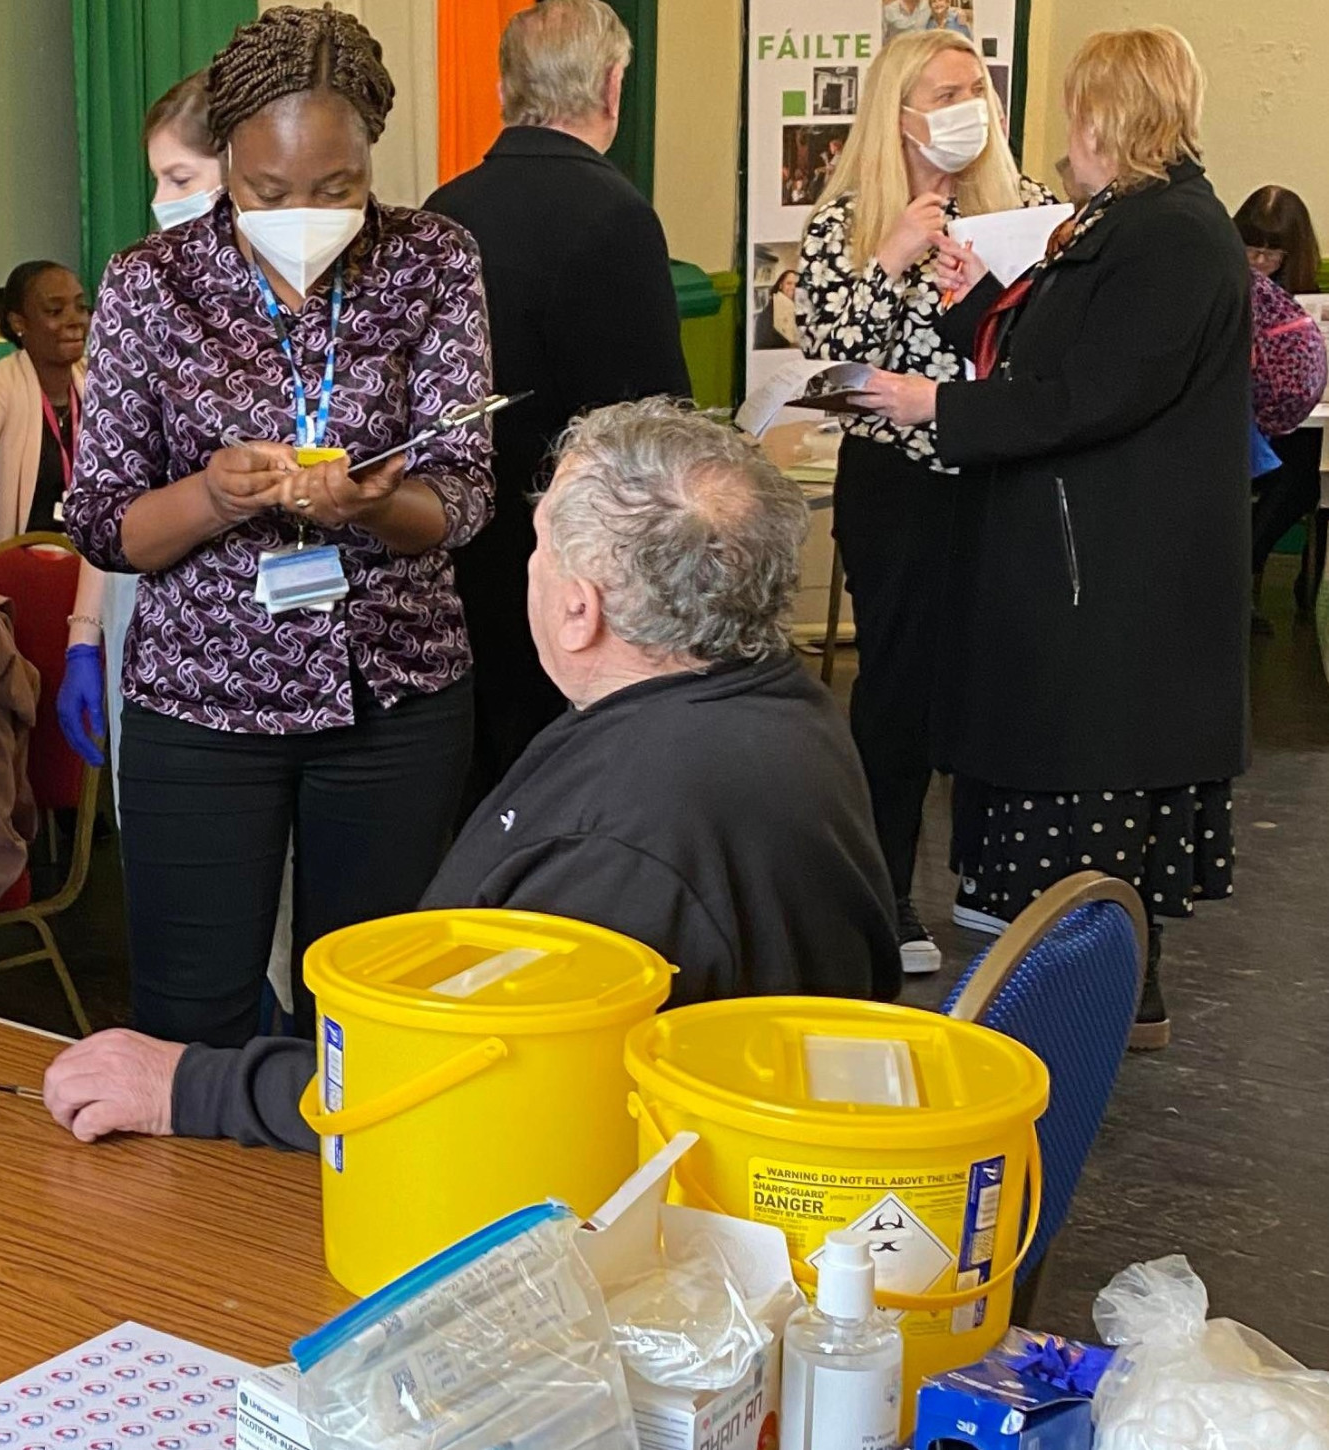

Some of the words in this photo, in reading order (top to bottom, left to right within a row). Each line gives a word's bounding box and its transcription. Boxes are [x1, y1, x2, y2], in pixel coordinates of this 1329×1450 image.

[758, 28, 871, 60] FÁILTE
[766, 1166, 819, 1182] WARNING
[821, 1174, 837, 1183] DO
[840, 1175, 862, 1185] NOT
[865, 1176, 887, 1186] FILL
[890, 1175, 924, 1186] ABOVE
[927, 1174, 944, 1184] THE
[946, 1171, 966, 1183] LINE
[754, 1191, 824, 1214] DANGER
[249, 1399, 279, 1423] Universal
